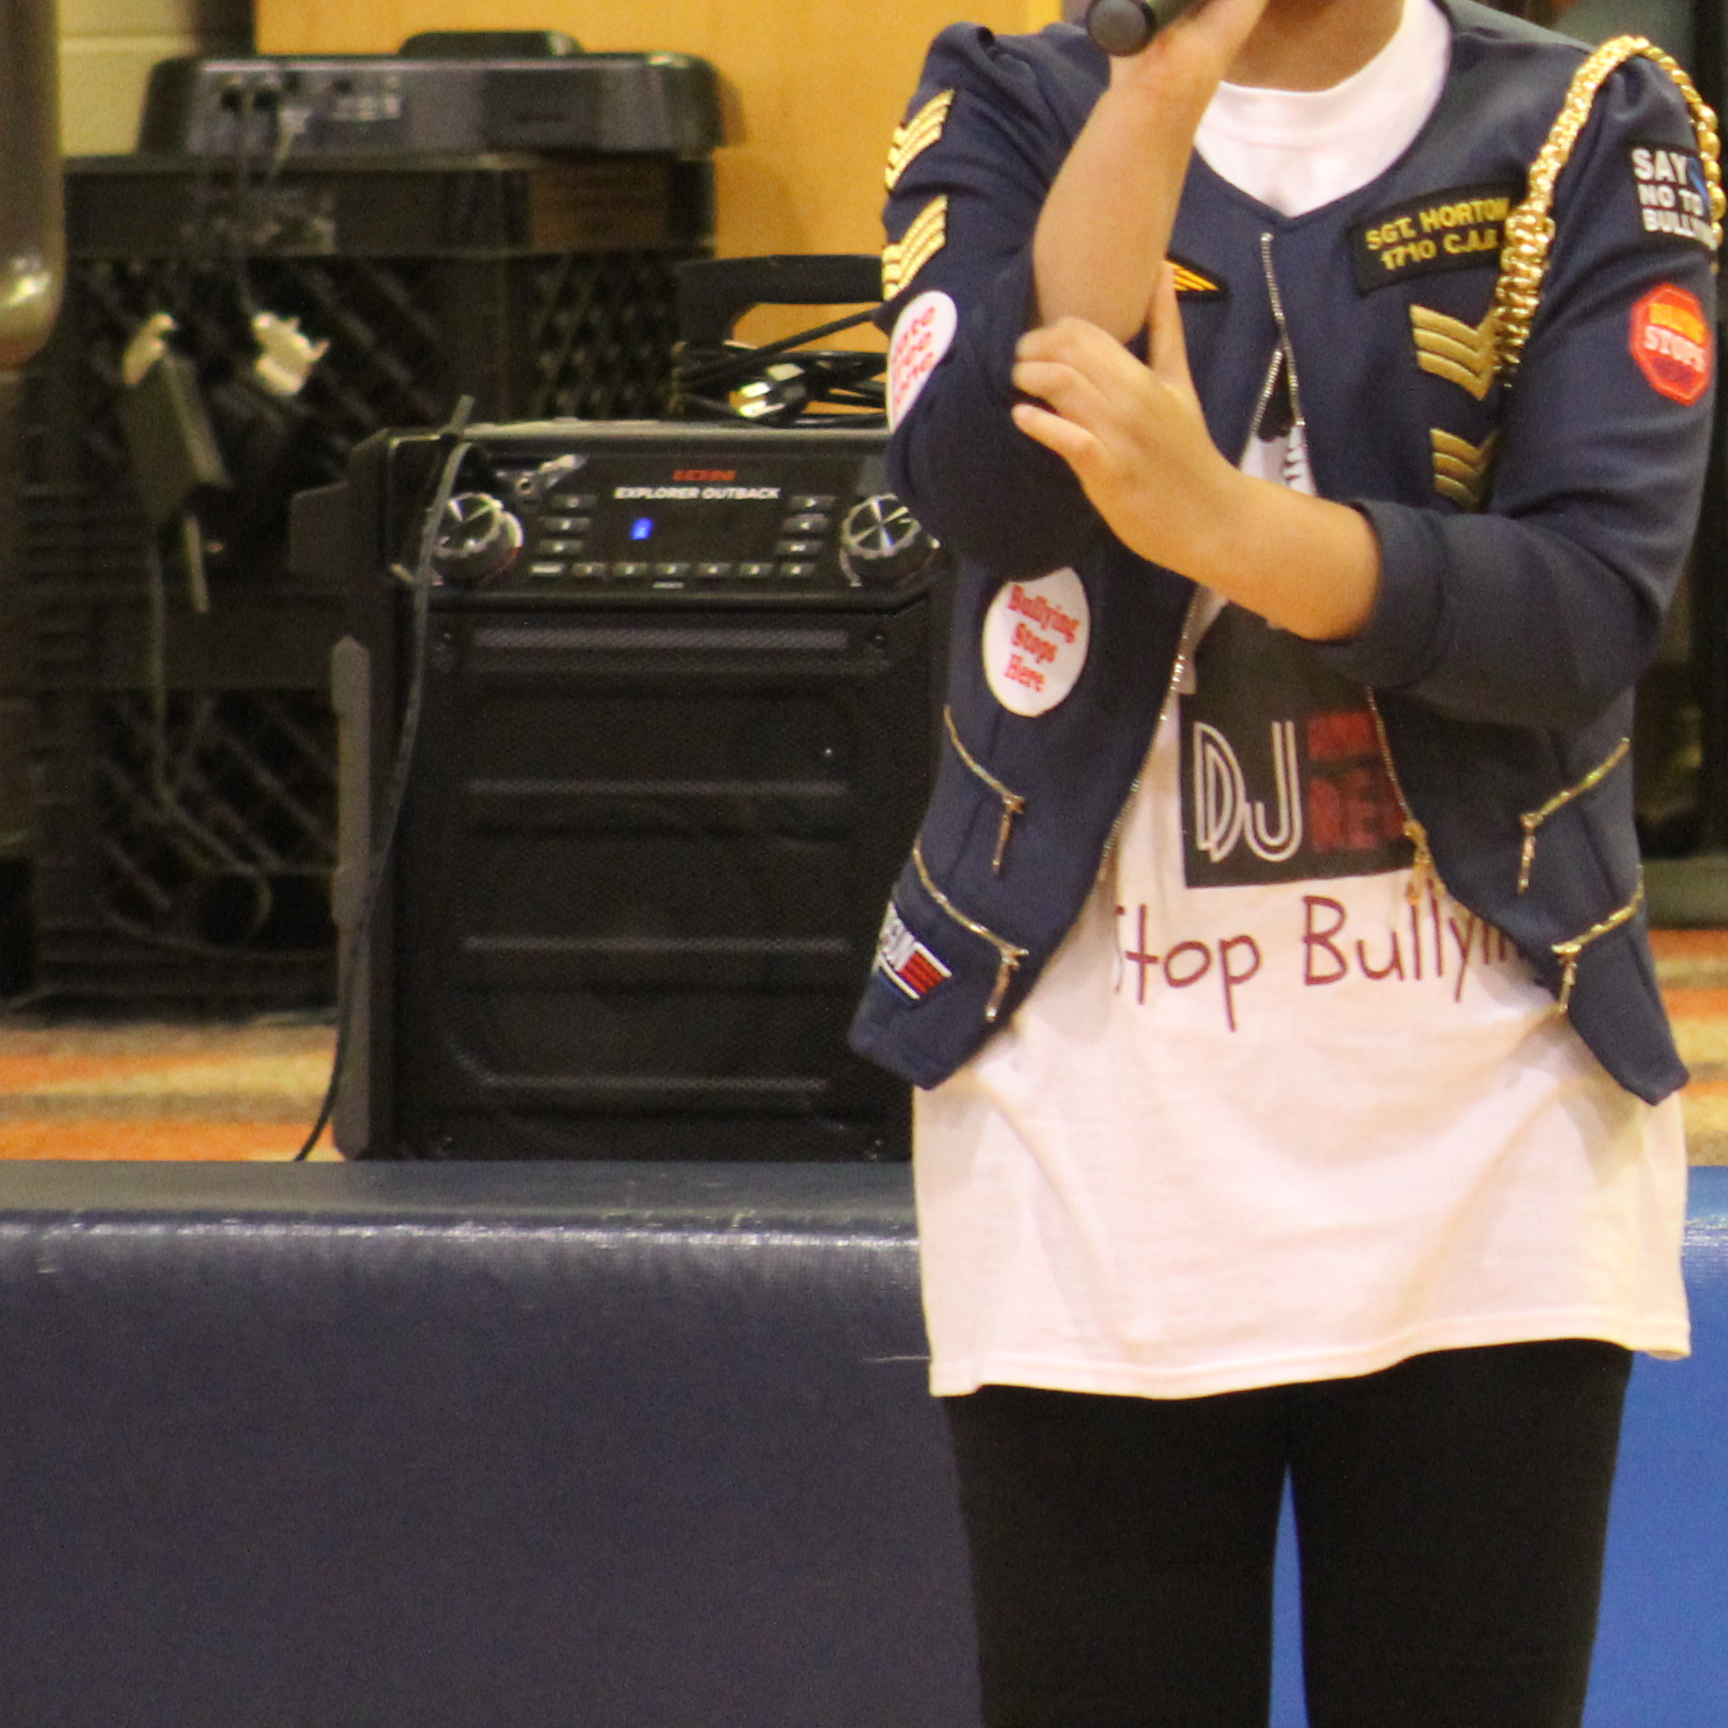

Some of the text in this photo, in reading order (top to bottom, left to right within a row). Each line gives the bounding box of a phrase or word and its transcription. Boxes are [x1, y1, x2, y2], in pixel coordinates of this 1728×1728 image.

[1632, 148, 1688, 185] SAY
[1637, 183, 1676, 208] NO
[614, 487, 781, 500] EXPLORER OUTBACK
[1007, 584, 1080, 644] Bullying
[1012, 621, 1058, 664] Stops
[1004, 653, 1045, 692] Here
[1193, 721, 1303, 862] DJ
[1114, 903, 1263, 1033] top
